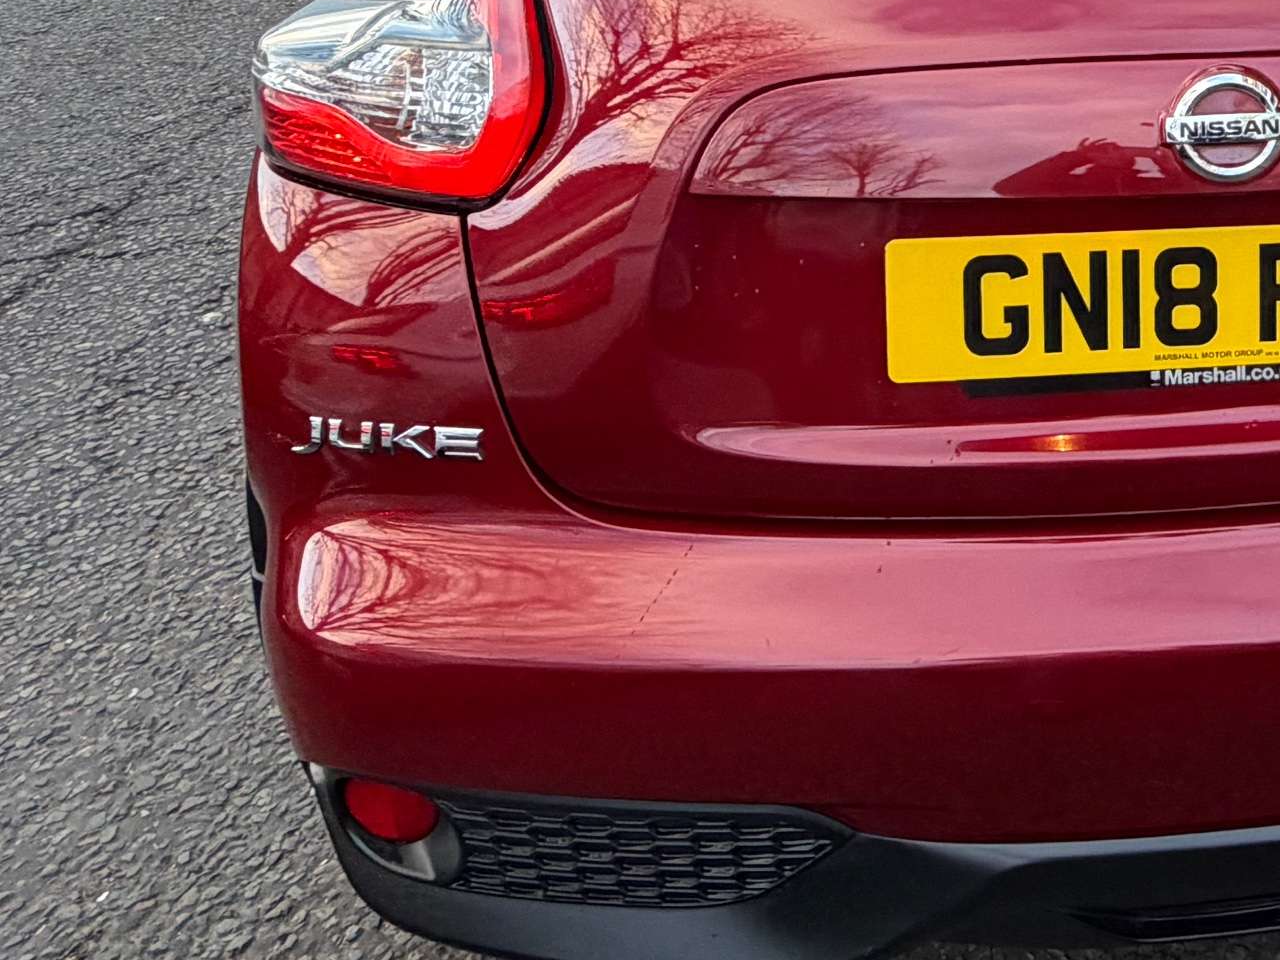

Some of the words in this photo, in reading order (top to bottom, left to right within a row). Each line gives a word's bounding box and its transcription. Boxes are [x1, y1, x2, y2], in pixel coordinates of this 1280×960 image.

[1180, 118, 1280, 139] NISSAN
[962, 246, 1219, 357] GN18
[1154, 352, 1199, 361] MARSHALL
[1201, 350, 1232, 359] MOTOR
[1234, 349, 1264, 357] GROUP
[290, 415, 485, 461] JUKE
